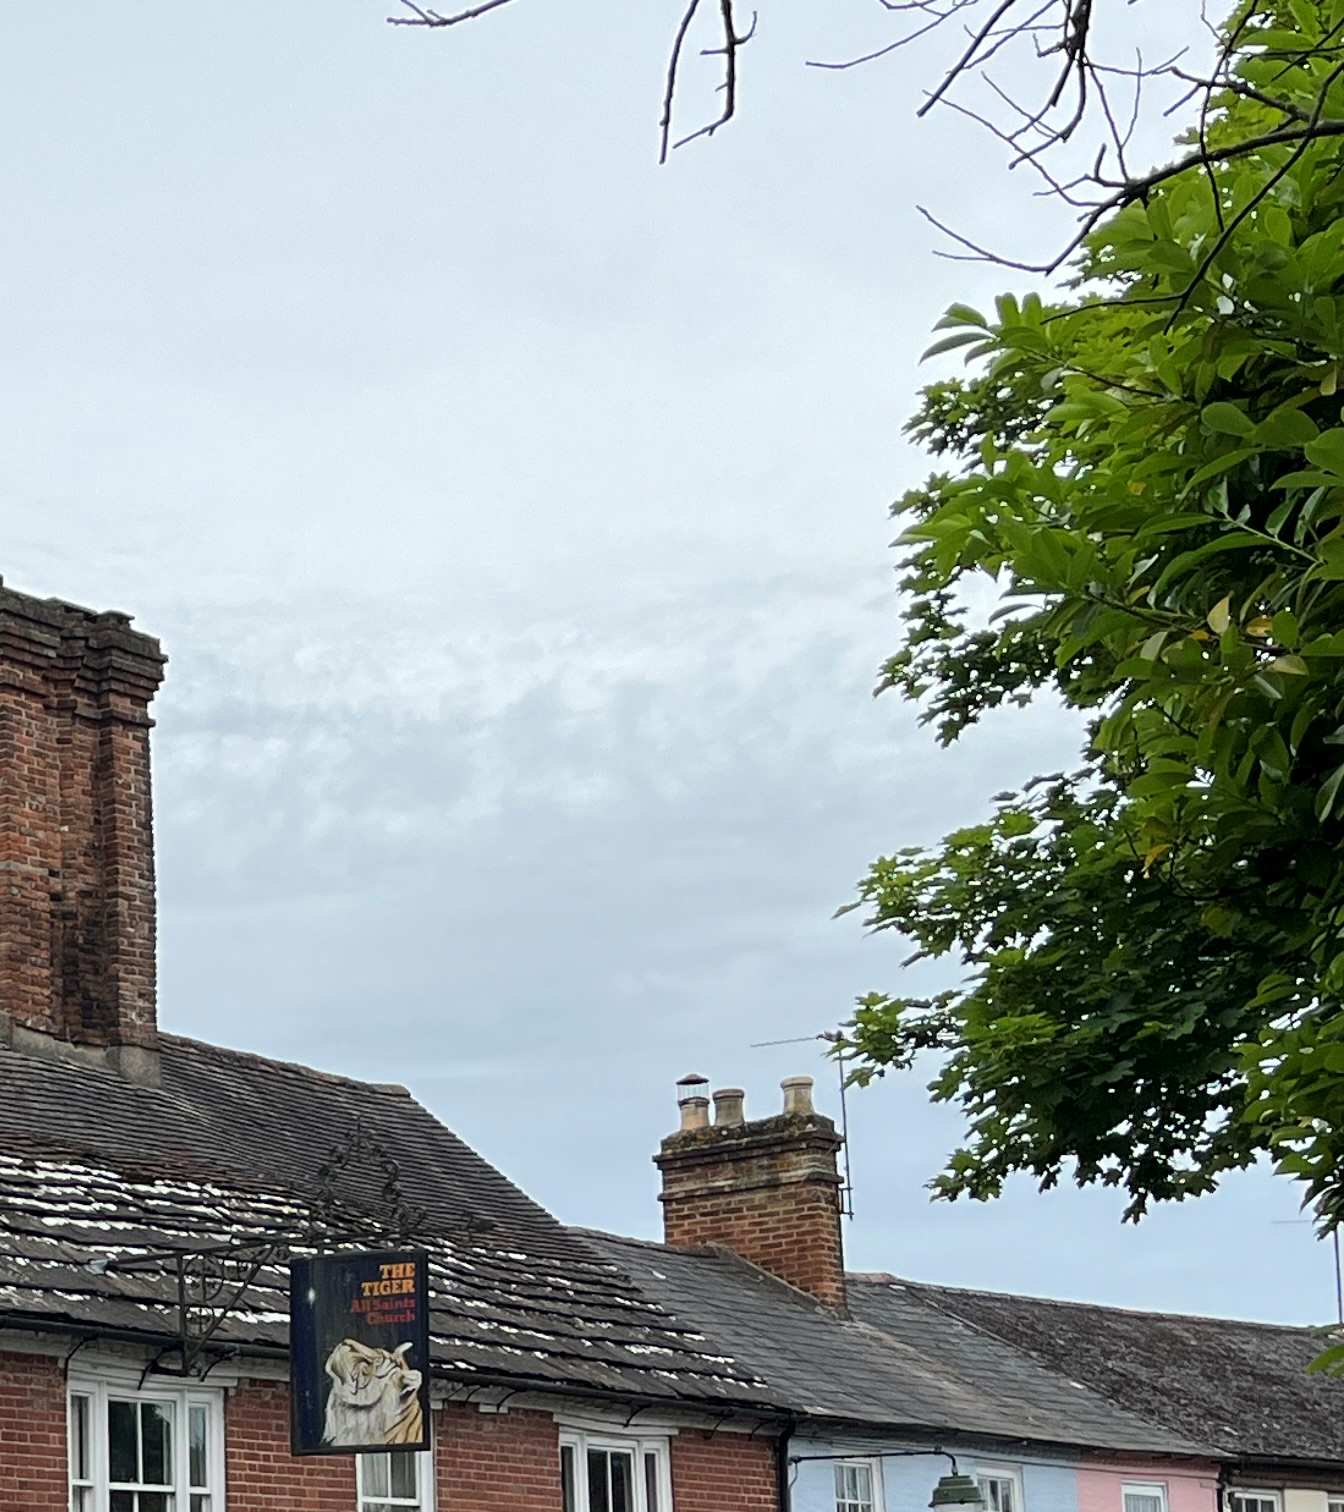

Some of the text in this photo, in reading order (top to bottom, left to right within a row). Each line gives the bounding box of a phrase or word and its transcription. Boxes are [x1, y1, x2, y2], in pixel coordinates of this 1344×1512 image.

[379, 1262, 416, 1279] THE
[361, 1279, 416, 1296] TIGER
[351, 1297, 416, 1313] All Saints
[367, 1309, 416, 1325] Church
